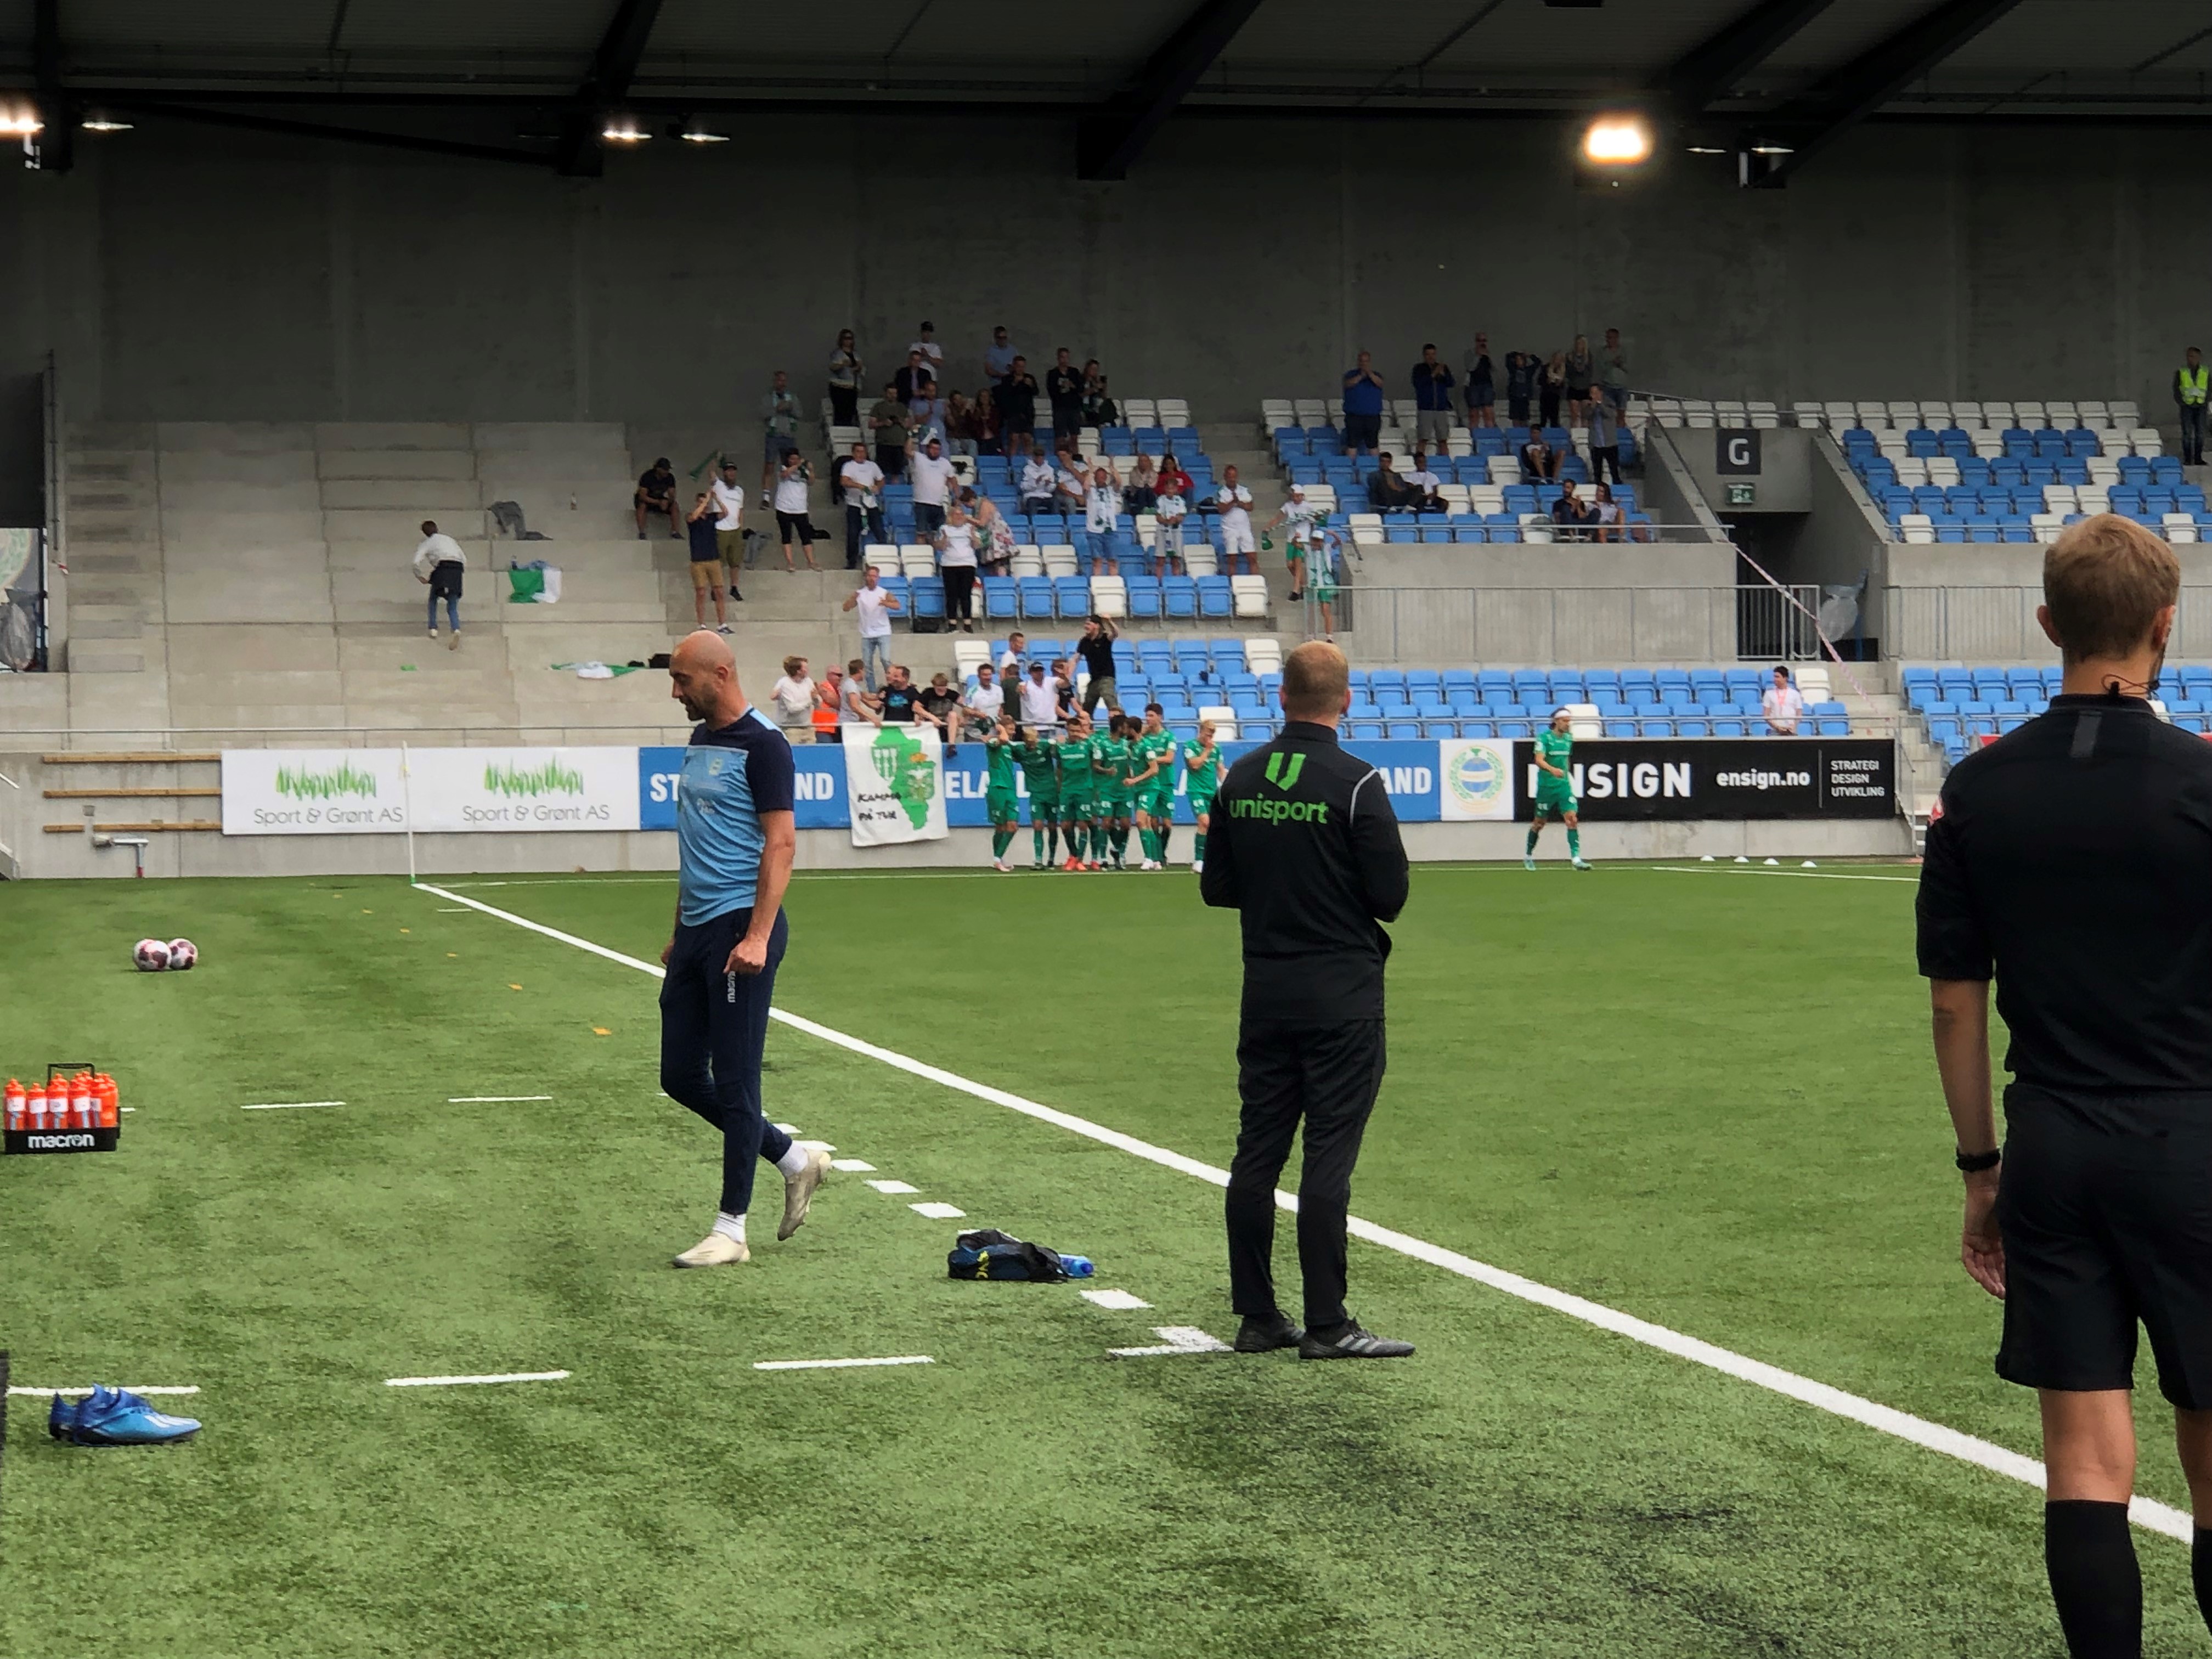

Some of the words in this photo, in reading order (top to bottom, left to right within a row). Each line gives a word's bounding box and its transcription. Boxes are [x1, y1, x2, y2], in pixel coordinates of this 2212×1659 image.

[1729, 438, 1750, 465] G
[1831, 760, 1879, 770] STRATEGI
[1716, 768, 1810, 790] ensign.no
[1831, 774, 1870, 784] DESIGN
[1831, 787, 1884, 797] UTVIKLING
[254, 808, 301, 826] Sport
[379, 807, 403, 822] AS
[462, 805, 509, 824] Sport
[585, 804, 610, 820] AS
[1229, 793, 1329, 826] unisport
[28, 1133, 95, 1149] macron
